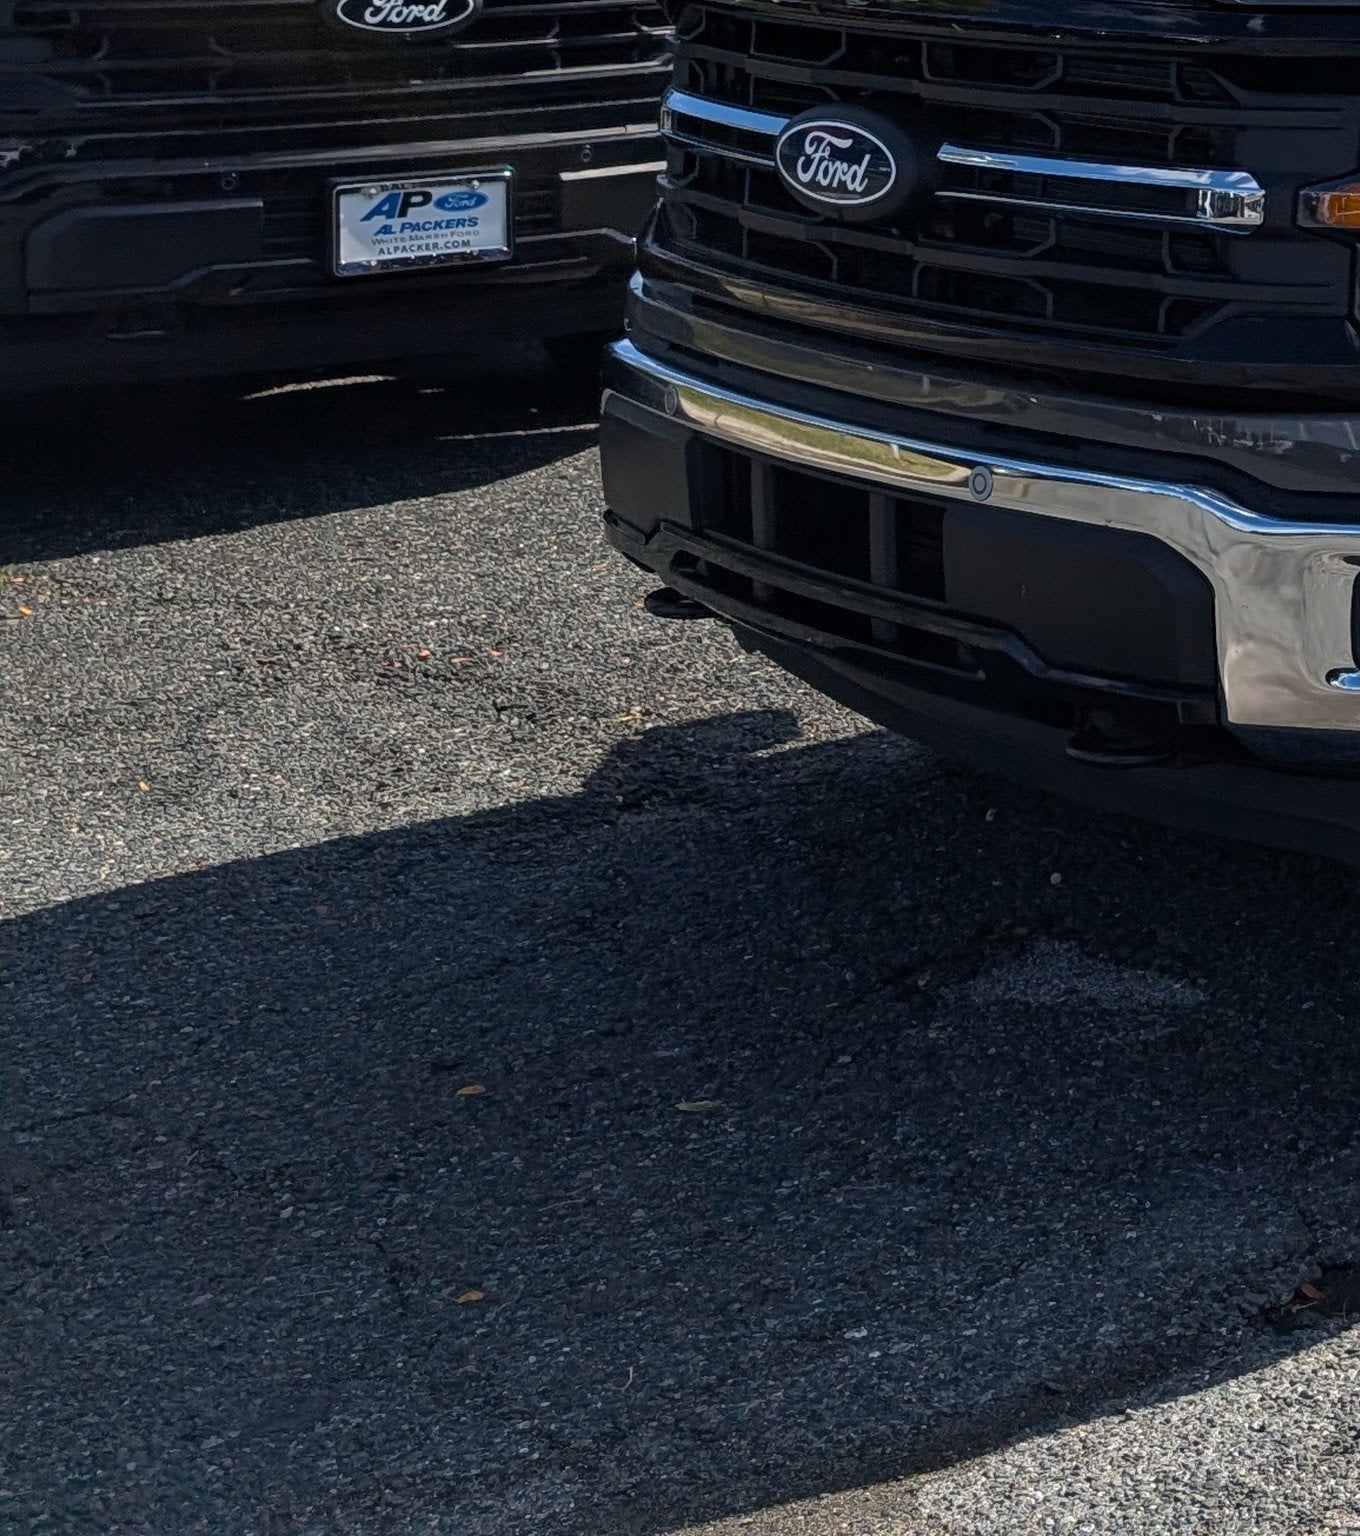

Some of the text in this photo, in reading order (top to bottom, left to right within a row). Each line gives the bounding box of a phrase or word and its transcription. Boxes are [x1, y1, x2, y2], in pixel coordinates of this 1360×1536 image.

[796, 130, 872, 193] Ford
[359, 190, 433, 222] AP
[374, 224, 397, 237] AL
[377, 239, 472, 256] ALPACKER.COM
